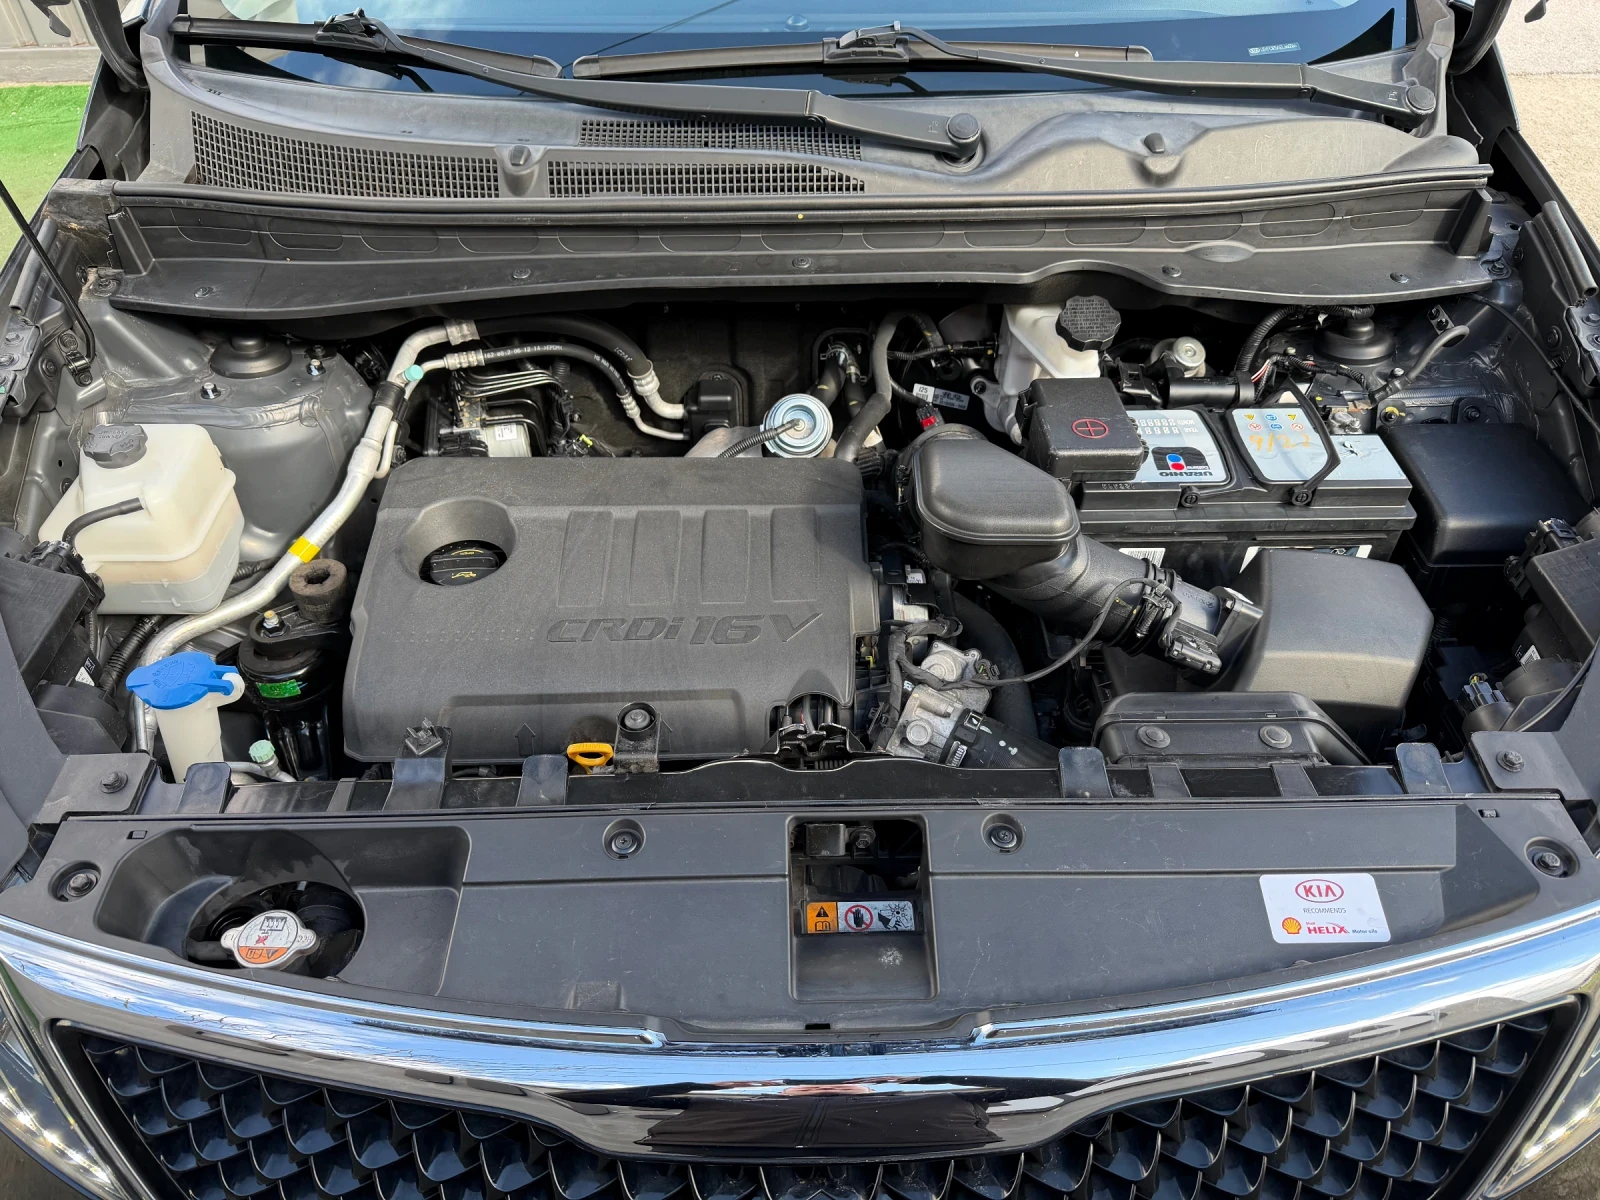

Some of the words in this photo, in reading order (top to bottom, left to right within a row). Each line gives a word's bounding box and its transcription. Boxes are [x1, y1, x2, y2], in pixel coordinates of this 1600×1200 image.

[546, 616, 686, 643] CRDi
[1302, 884, 1337, 898] KIA
[1306, 925, 1349, 935] HELIX
